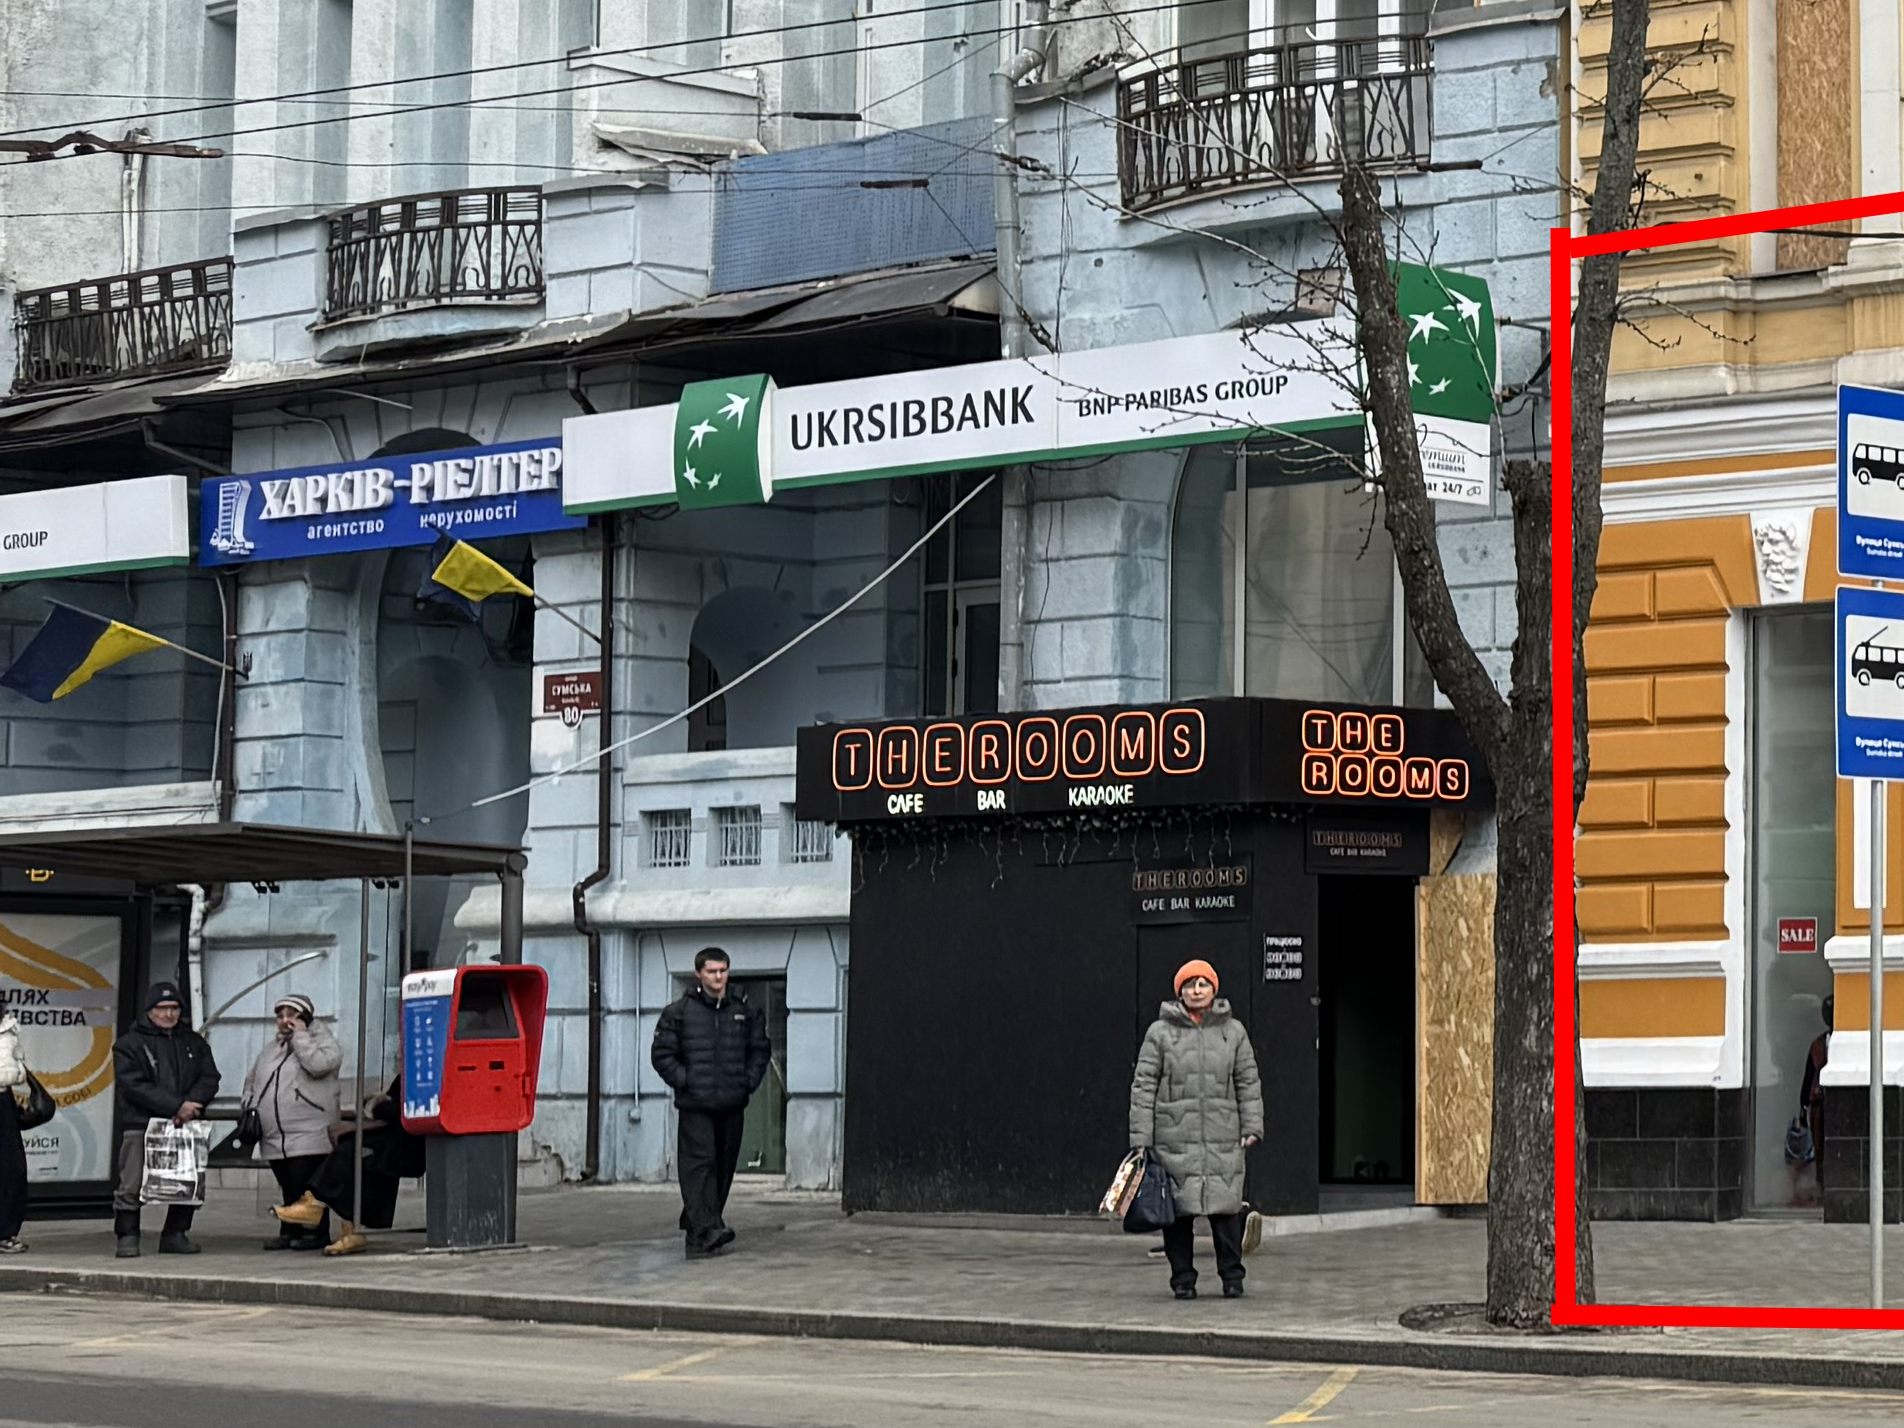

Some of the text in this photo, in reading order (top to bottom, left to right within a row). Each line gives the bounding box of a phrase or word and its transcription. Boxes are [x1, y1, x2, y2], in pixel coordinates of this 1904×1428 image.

[790, 376, 1289, 452] UKRSIBBANK BNP PARIBAS GROUP
[1443, 481, 1463, 494] 24/7
[307, 500, 518, 541] агентство нерухомості
[3, 530, 49, 551] GROUP
[552, 682, 592, 697] СУМСЬКА
[564, 706, 580, 723] 80
[1307, 714, 1398, 751] THE
[1307, 757, 1464, 795] ROOMS
[887, 784, 1134, 815] CAFE BAR KARAOKE
[1142, 895, 1235, 911] CAFE BAR KARAOKE
[1781, 930, 1814, 943] SALE
